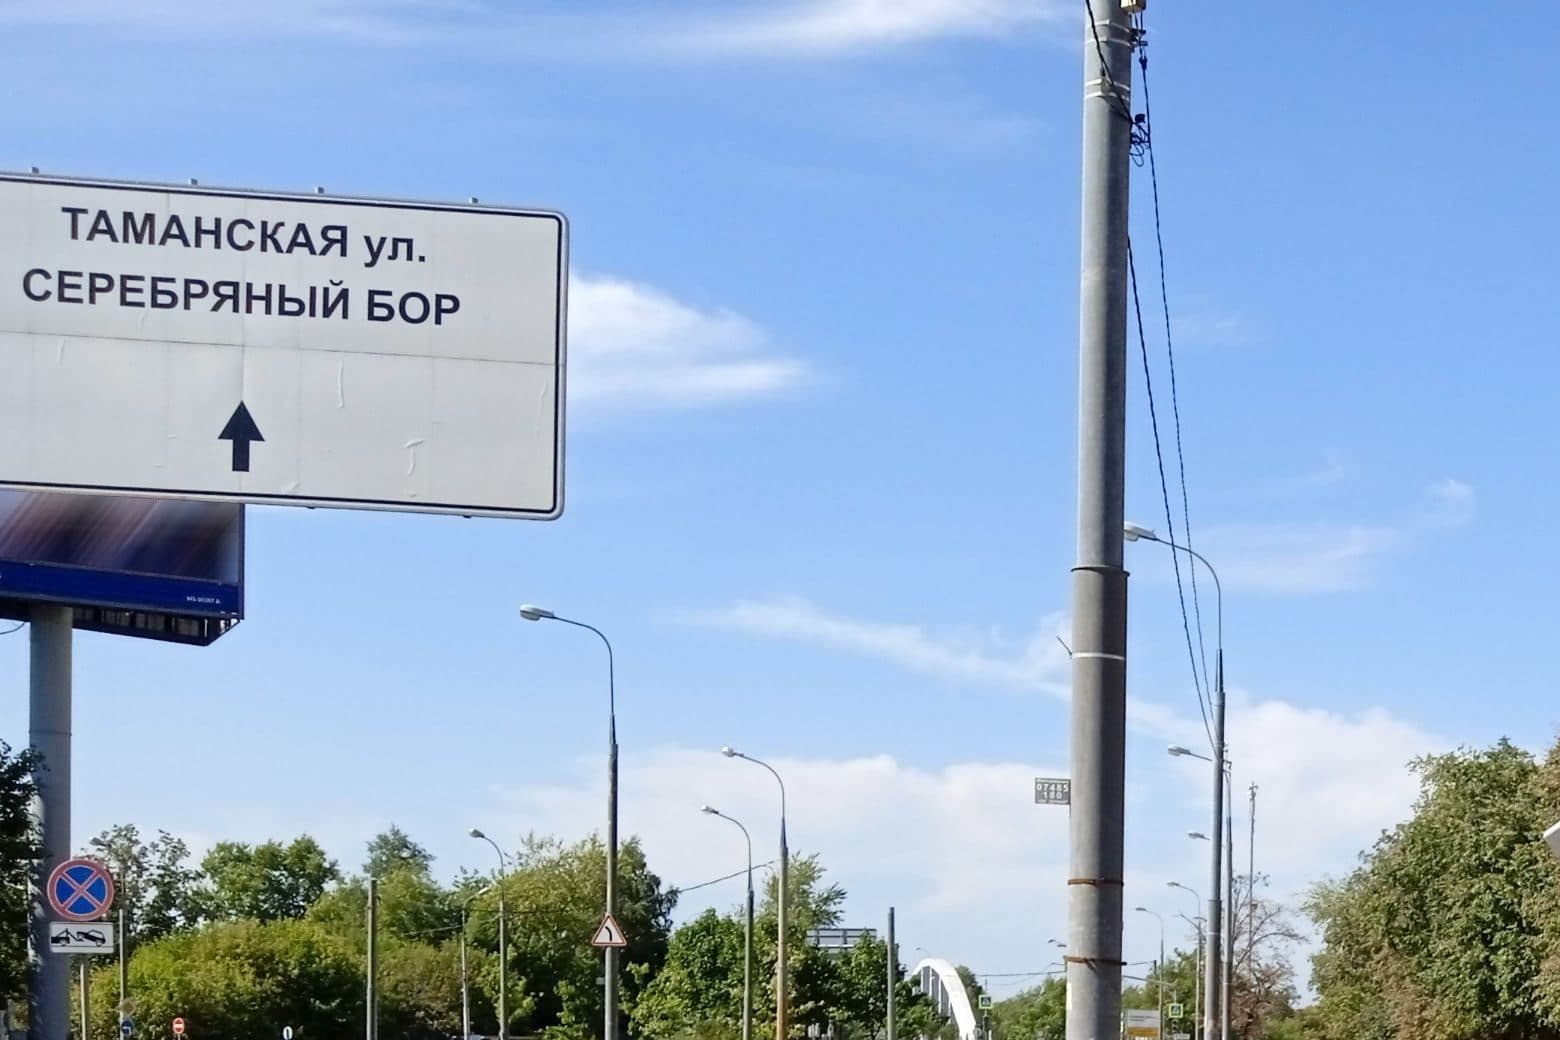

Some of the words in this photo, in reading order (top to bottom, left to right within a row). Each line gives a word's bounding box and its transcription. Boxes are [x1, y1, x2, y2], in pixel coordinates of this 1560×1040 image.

[61, 206, 348, 258] ТАМАНСКАЯ
[364, 235, 426, 267] ул.
[22, 257, 350, 320] СЕРЕБРЯНЫЙ
[366, 290, 461, 326] БОР
